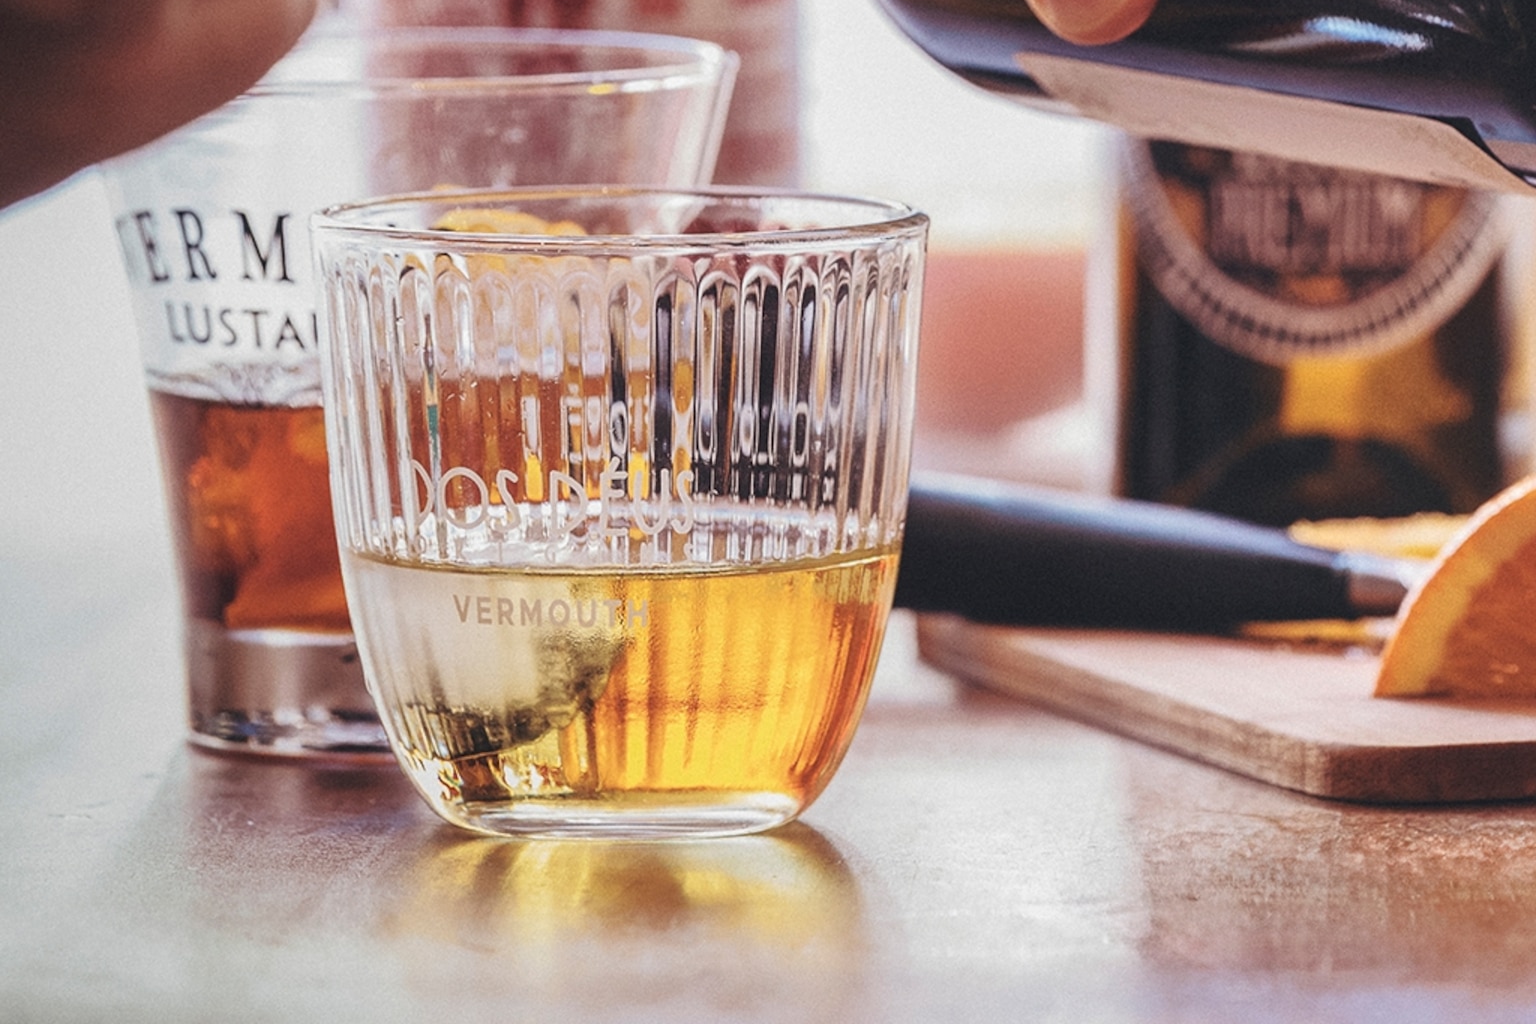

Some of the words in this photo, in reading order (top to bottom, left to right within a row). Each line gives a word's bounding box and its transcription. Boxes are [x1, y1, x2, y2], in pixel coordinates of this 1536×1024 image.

[116, 208, 295, 284] ERM
[409, 458, 521, 533] DOS
[452, 593, 649, 629] VERMOUTH
